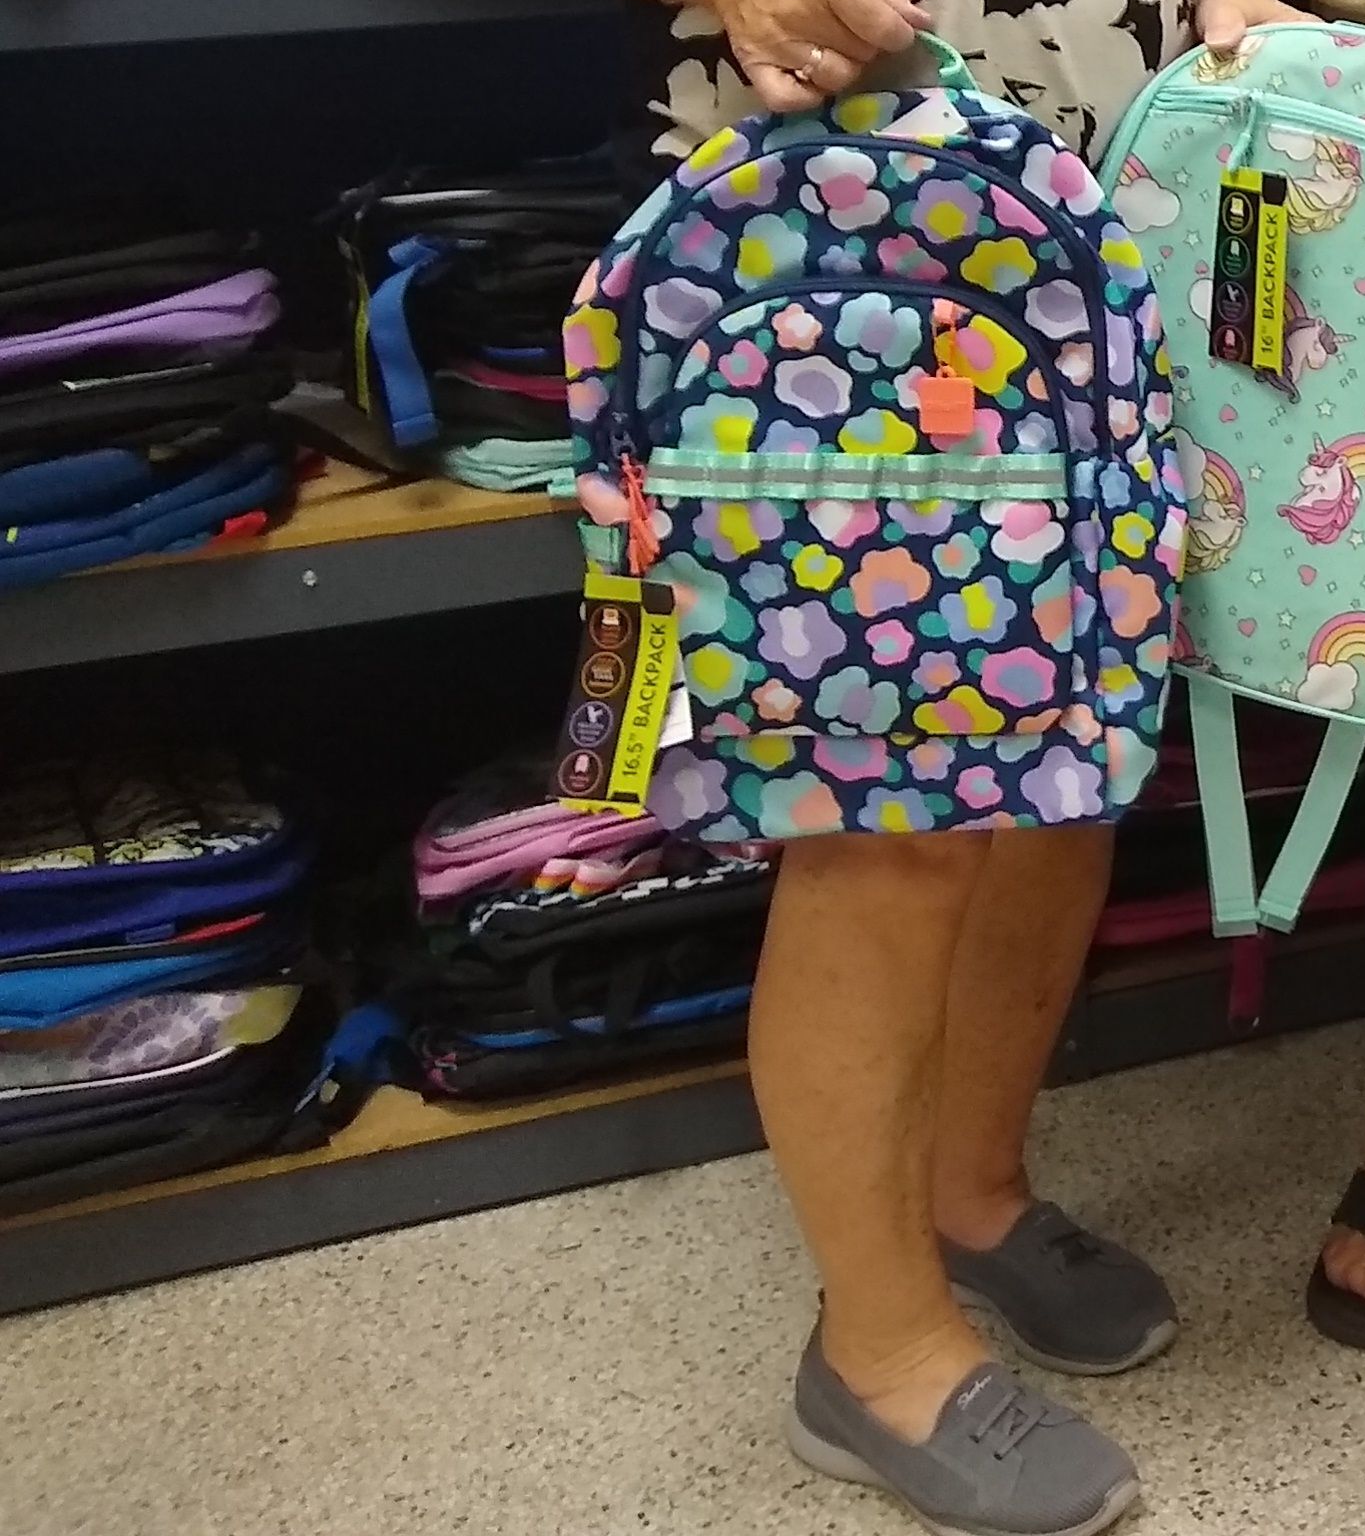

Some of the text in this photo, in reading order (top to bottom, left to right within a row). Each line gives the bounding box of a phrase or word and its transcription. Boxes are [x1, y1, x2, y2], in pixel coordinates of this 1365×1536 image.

[1260, 211, 1279, 354] 16" BACKPACK
[622, 622, 667, 777] 16.5" BACKPACK
